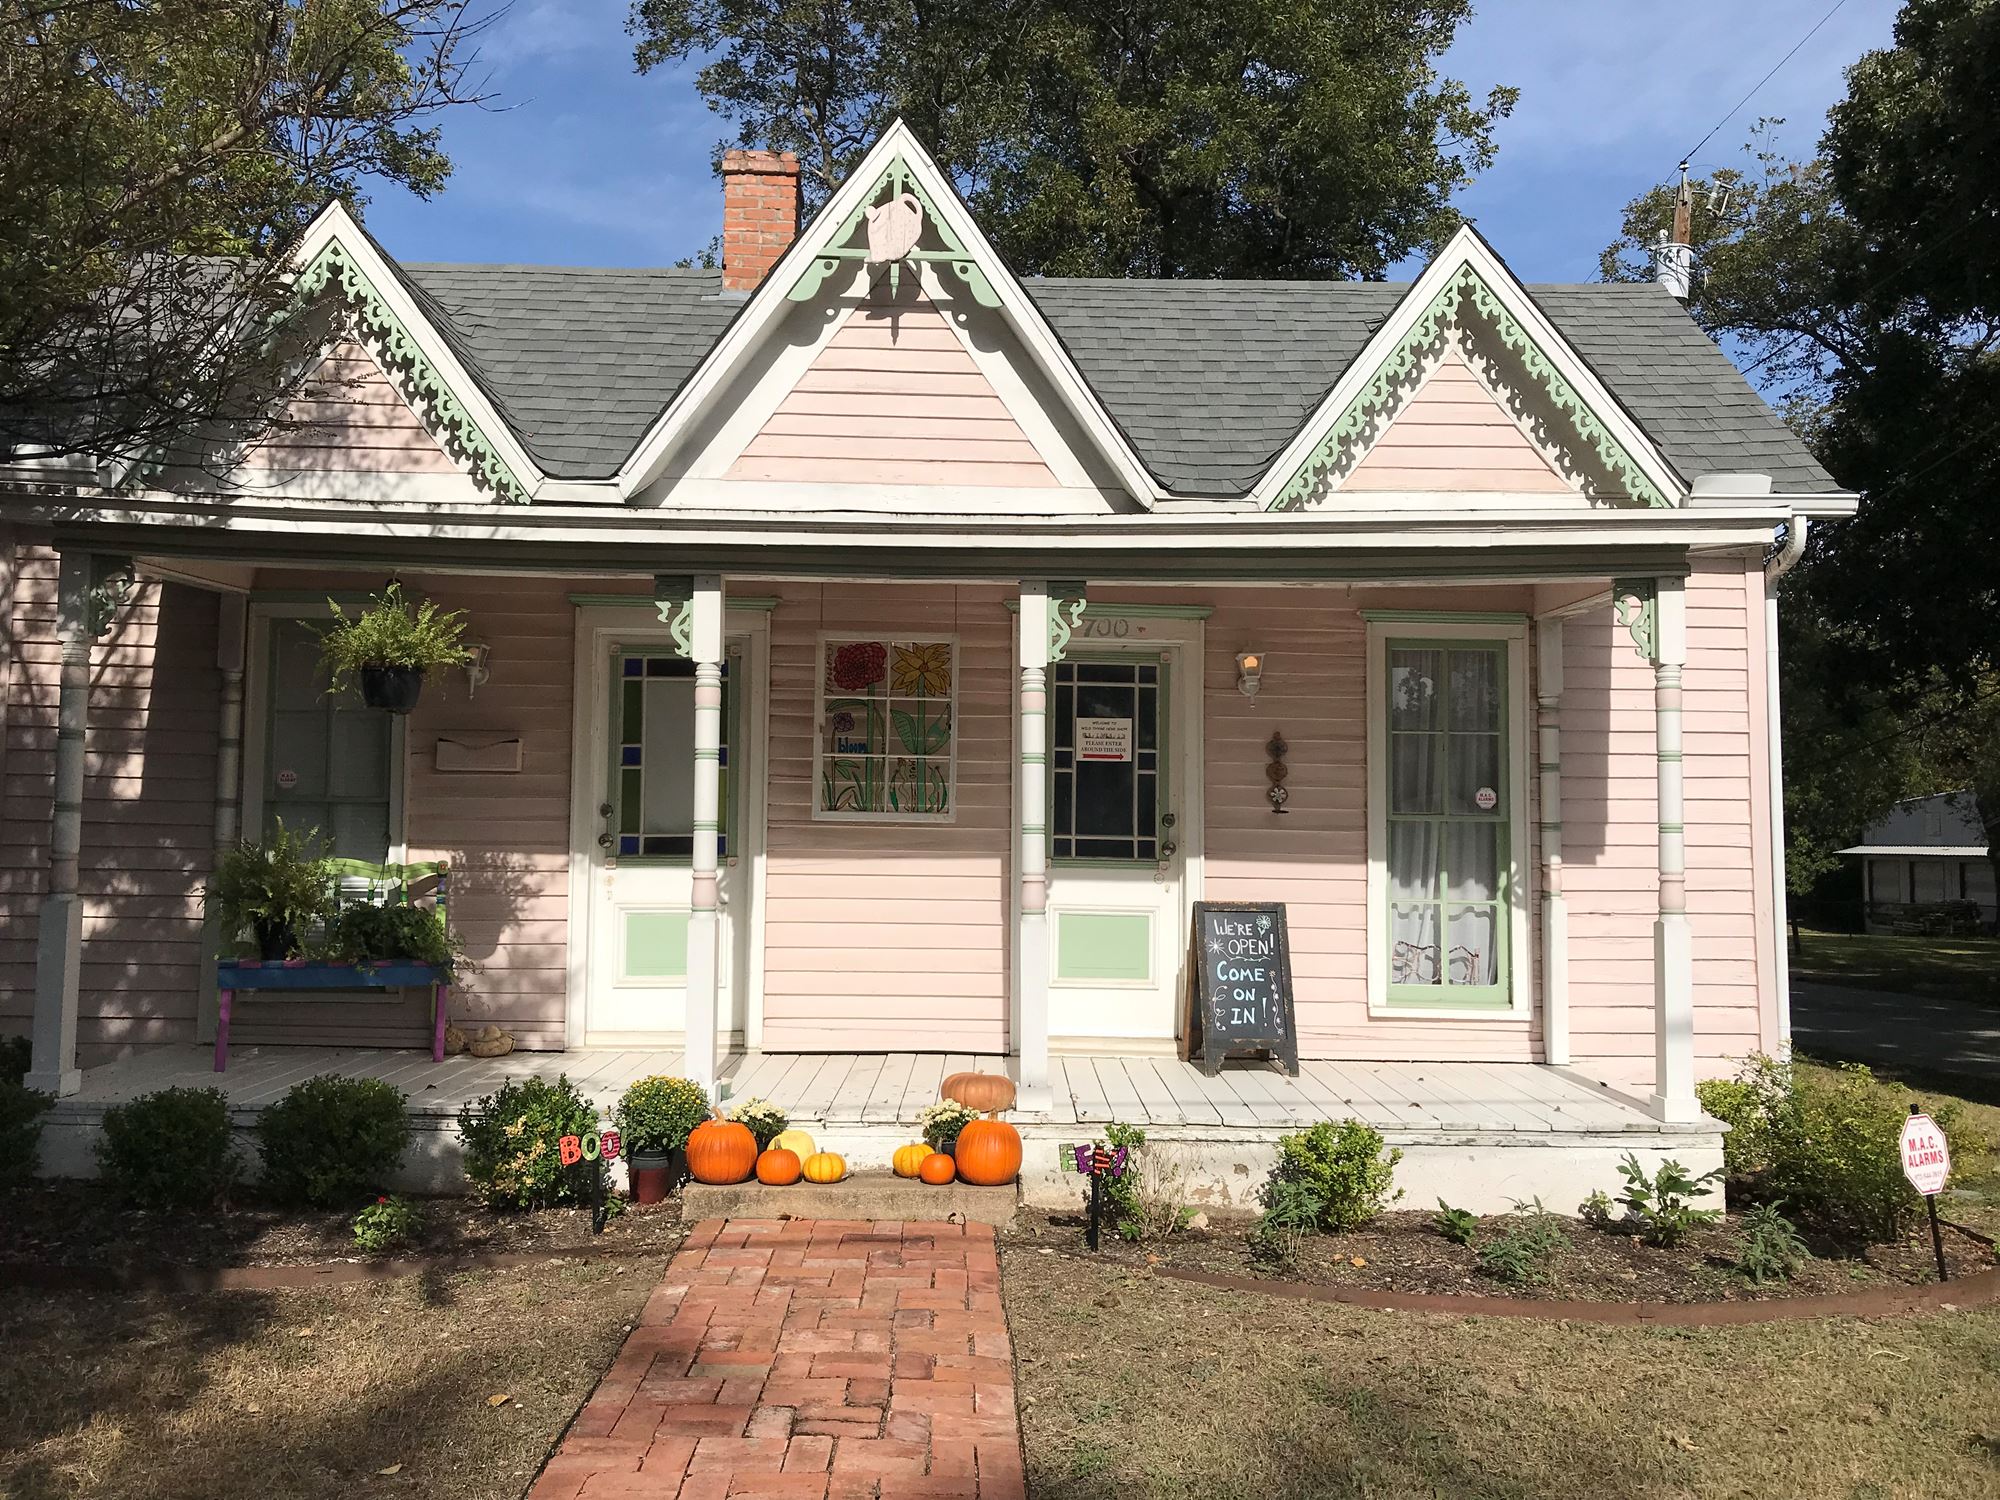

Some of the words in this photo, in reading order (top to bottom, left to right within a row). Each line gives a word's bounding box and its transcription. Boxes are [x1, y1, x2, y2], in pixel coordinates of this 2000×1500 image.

[1083, 618, 1129, 638] 700
[1228, 933, 1275, 956] OPEN!
[1216, 960, 1265, 982] COME
[1232, 988, 1256, 1001] ON
[1907, 1135, 1938, 1152] M.A.C.
[1907, 1150, 1944, 1168] ALARMS
